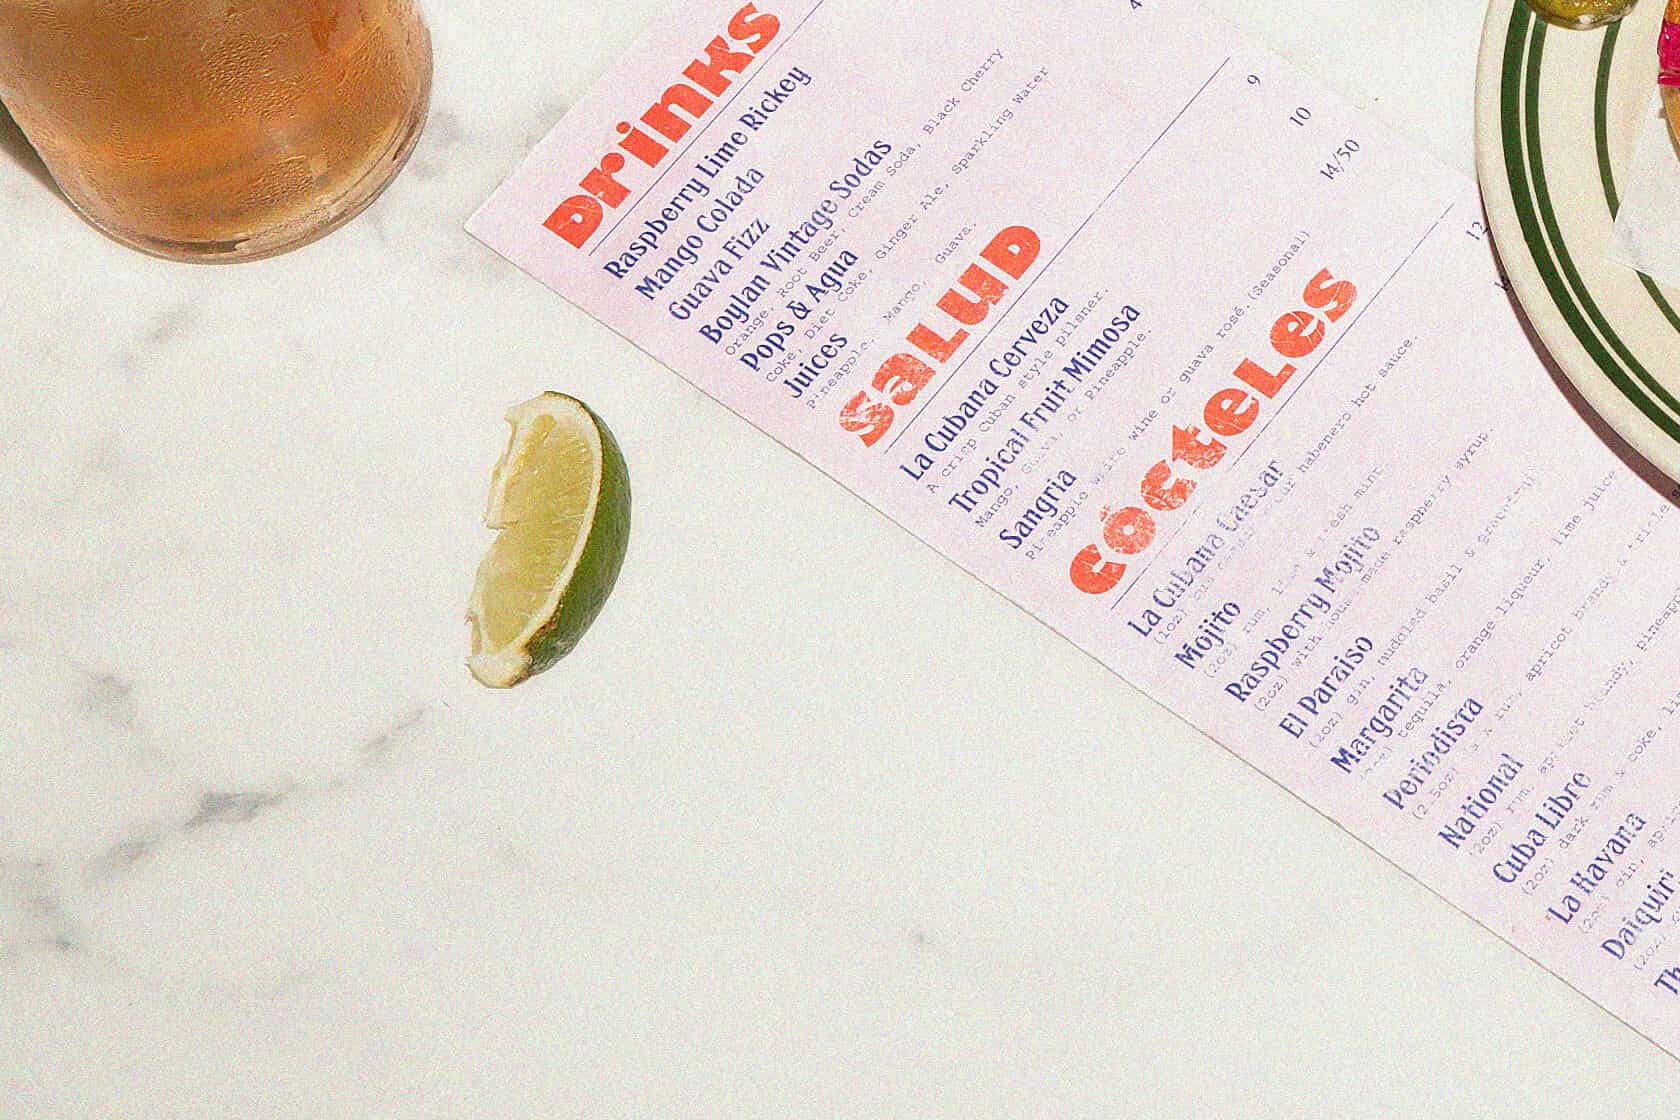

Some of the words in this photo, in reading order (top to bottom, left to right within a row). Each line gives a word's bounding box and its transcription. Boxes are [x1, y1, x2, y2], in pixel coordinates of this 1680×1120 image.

[1246, 73, 1261, 85] 9
[1288, 106, 1311, 126] 10
[602, 177, 710, 279] Raspberry
[694, 131, 748, 178] Lime
[737, 66, 812, 131] Rickey
[724, 306, 774, 356] Orange,
[775, 266, 808, 298] Root
[807, 227, 845, 262] Beer,
[847, 179, 886, 218] Cream
[885, 142, 921, 177] Soda,
[921, 96, 961, 135] Black
[960, 47, 1004, 92] Cherry
[1319, 138, 1360, 180] 14/50
[633, 234, 703, 301] Mango
[695, 167, 765, 233] Colada
[667, 258, 734, 320] Guava
[721, 218, 770, 260] Fizz
[697, 274, 771, 344] Boylan
[759, 199, 838, 272] Vintage
[828, 139, 892, 199] Sodas
[765, 348, 803, 382] Coke,
[803, 308, 835, 340] Diet
[836, 268, 873, 302] Coke,
[874, 213, 918, 259] Ginger
[918, 183, 949, 211] Ale,
[950, 107, 1014, 175] Sparkling
[1011, 66, 1048, 104] Water
[738, 320, 795, 372] Pops
[785, 299, 812, 320] &
[804, 249, 858, 303] Agua
[782, 332, 848, 399] Juices
[898, 452, 934, 481] La
[923, 378, 999, 452] Cubana
[988, 296, 1069, 378] Cerveza
[925, 483, 939, 494] A
[940, 437, 977, 477] crisp
[977, 393, 1016, 432] Cuban
[1017, 349, 1054, 389] style
[1054, 288, 1109, 347] pilsner.
[947, 427, 1029, 513] Tropical
[1018, 378, 1072, 429] Fruit
[1061, 304, 1141, 383] Mimosa
[1127, 409, 1158, 441] wine
[1159, 386, 1177, 404] or
[1178, 343, 1214, 384] guava
[1349, 382, 1376, 408] hot
[1377, 335, 1418, 378] sauce.
[973, 484, 1019, 528] Mango,
[1083, 329, 1152, 400] Pineapple.
[998, 469, 1077, 550] Sangria
[1126, 608, 1162, 637] La
[1151, 533, 1223, 608] Cubana
[1215, 459, 1284, 532] Caesar
[1290, 635, 1323, 667] with
[1455, 428, 1493, 470] syrup.
[1173, 601, 1241, 669] Mojito
[1223, 592, 1331, 703] Raspberry
[1313, 526, 1380, 594] Mojito
[1241, 606, 1271, 634] rum,
[1345, 675, 1376, 706] gin,
[1423, 563, 1463, 604] basil
[1396, 679, 1452, 738] tequila,
[1454, 620, 1496, 668] orange
[1494, 557, 1551, 616] liqueur,
[1550, 514, 1582, 546] lime
[1524, 626, 1573, 682] apricot
[1277, 711, 1308, 739] El
[1296, 635, 1373, 716] Paraiso
[1329, 666, 1428, 774] Margarita
[1381, 697, 1484, 810] Periodista
[1437, 752, 1524, 849] National
[1557, 815, 1589, 849] dark
[1626, 725, 1662, 762] coke,
[1492, 828, 1547, 883] Cuba
[1534, 772, 1588, 830] Libre
[1546, 894, 1581, 924] La
[1568, 812, 1646, 895] Havana
[1599, 868, 1675, 960] Daiquiri
